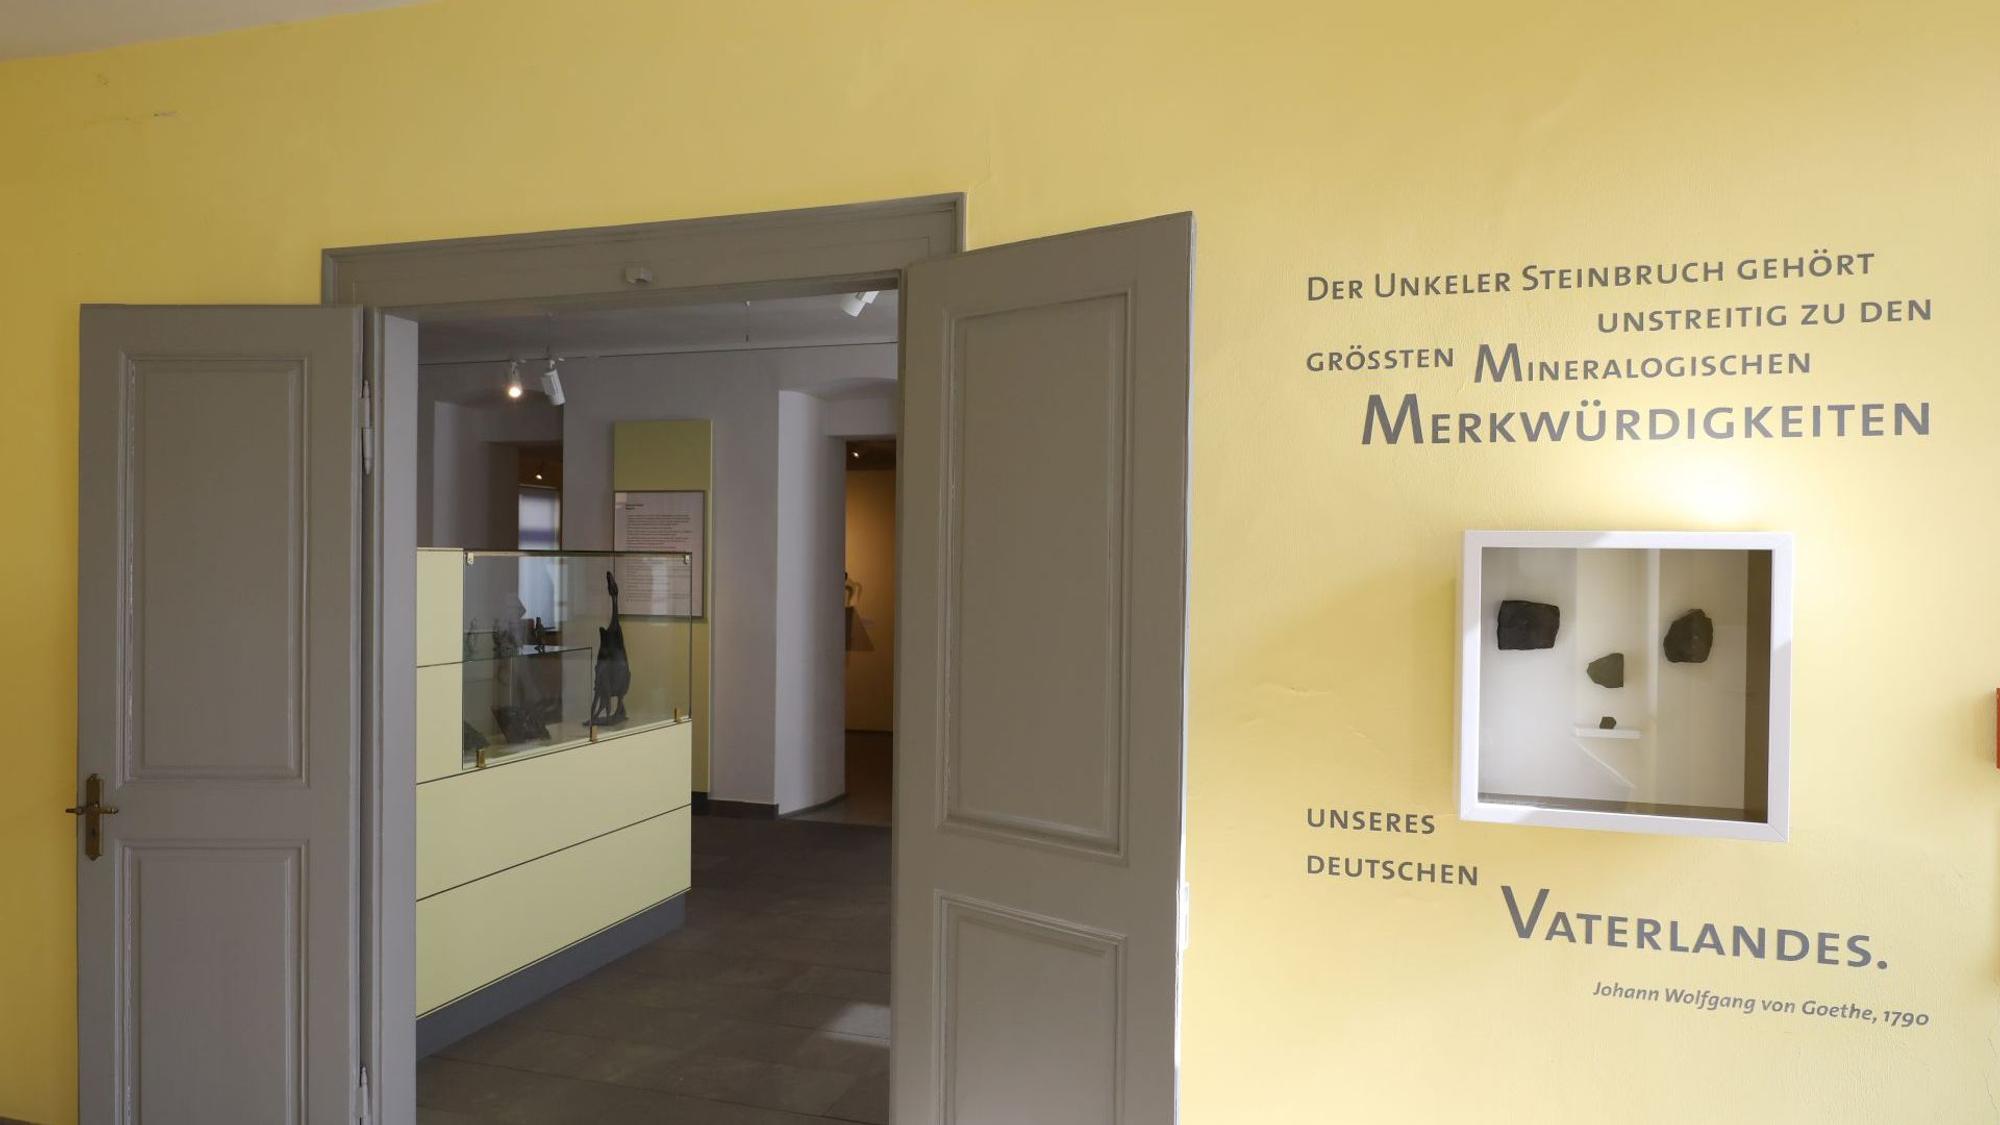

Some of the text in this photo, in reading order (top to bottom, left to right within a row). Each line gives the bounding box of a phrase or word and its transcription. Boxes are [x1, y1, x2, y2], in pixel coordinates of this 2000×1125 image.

[1308, 249, 1875, 301] DER UNKELER STEINBRUCH GEHÖRT
[1598, 299, 1931, 333] UNSTREITIG ZU DEN
[1306, 343, 1810, 383] GRÖSSTEN MINERALOGISCHEN
[1361, 393, 1929, 445] MERKWÜRDIGKEITEN
[1308, 808, 1435, 834] UNSERES
[1308, 855, 1477, 886] DEUTSCHEN
[1500, 885, 1887, 970] VATERLANDES.
[1593, 982, 1929, 1027] Johann Wolfgang von Goethe, 1790
